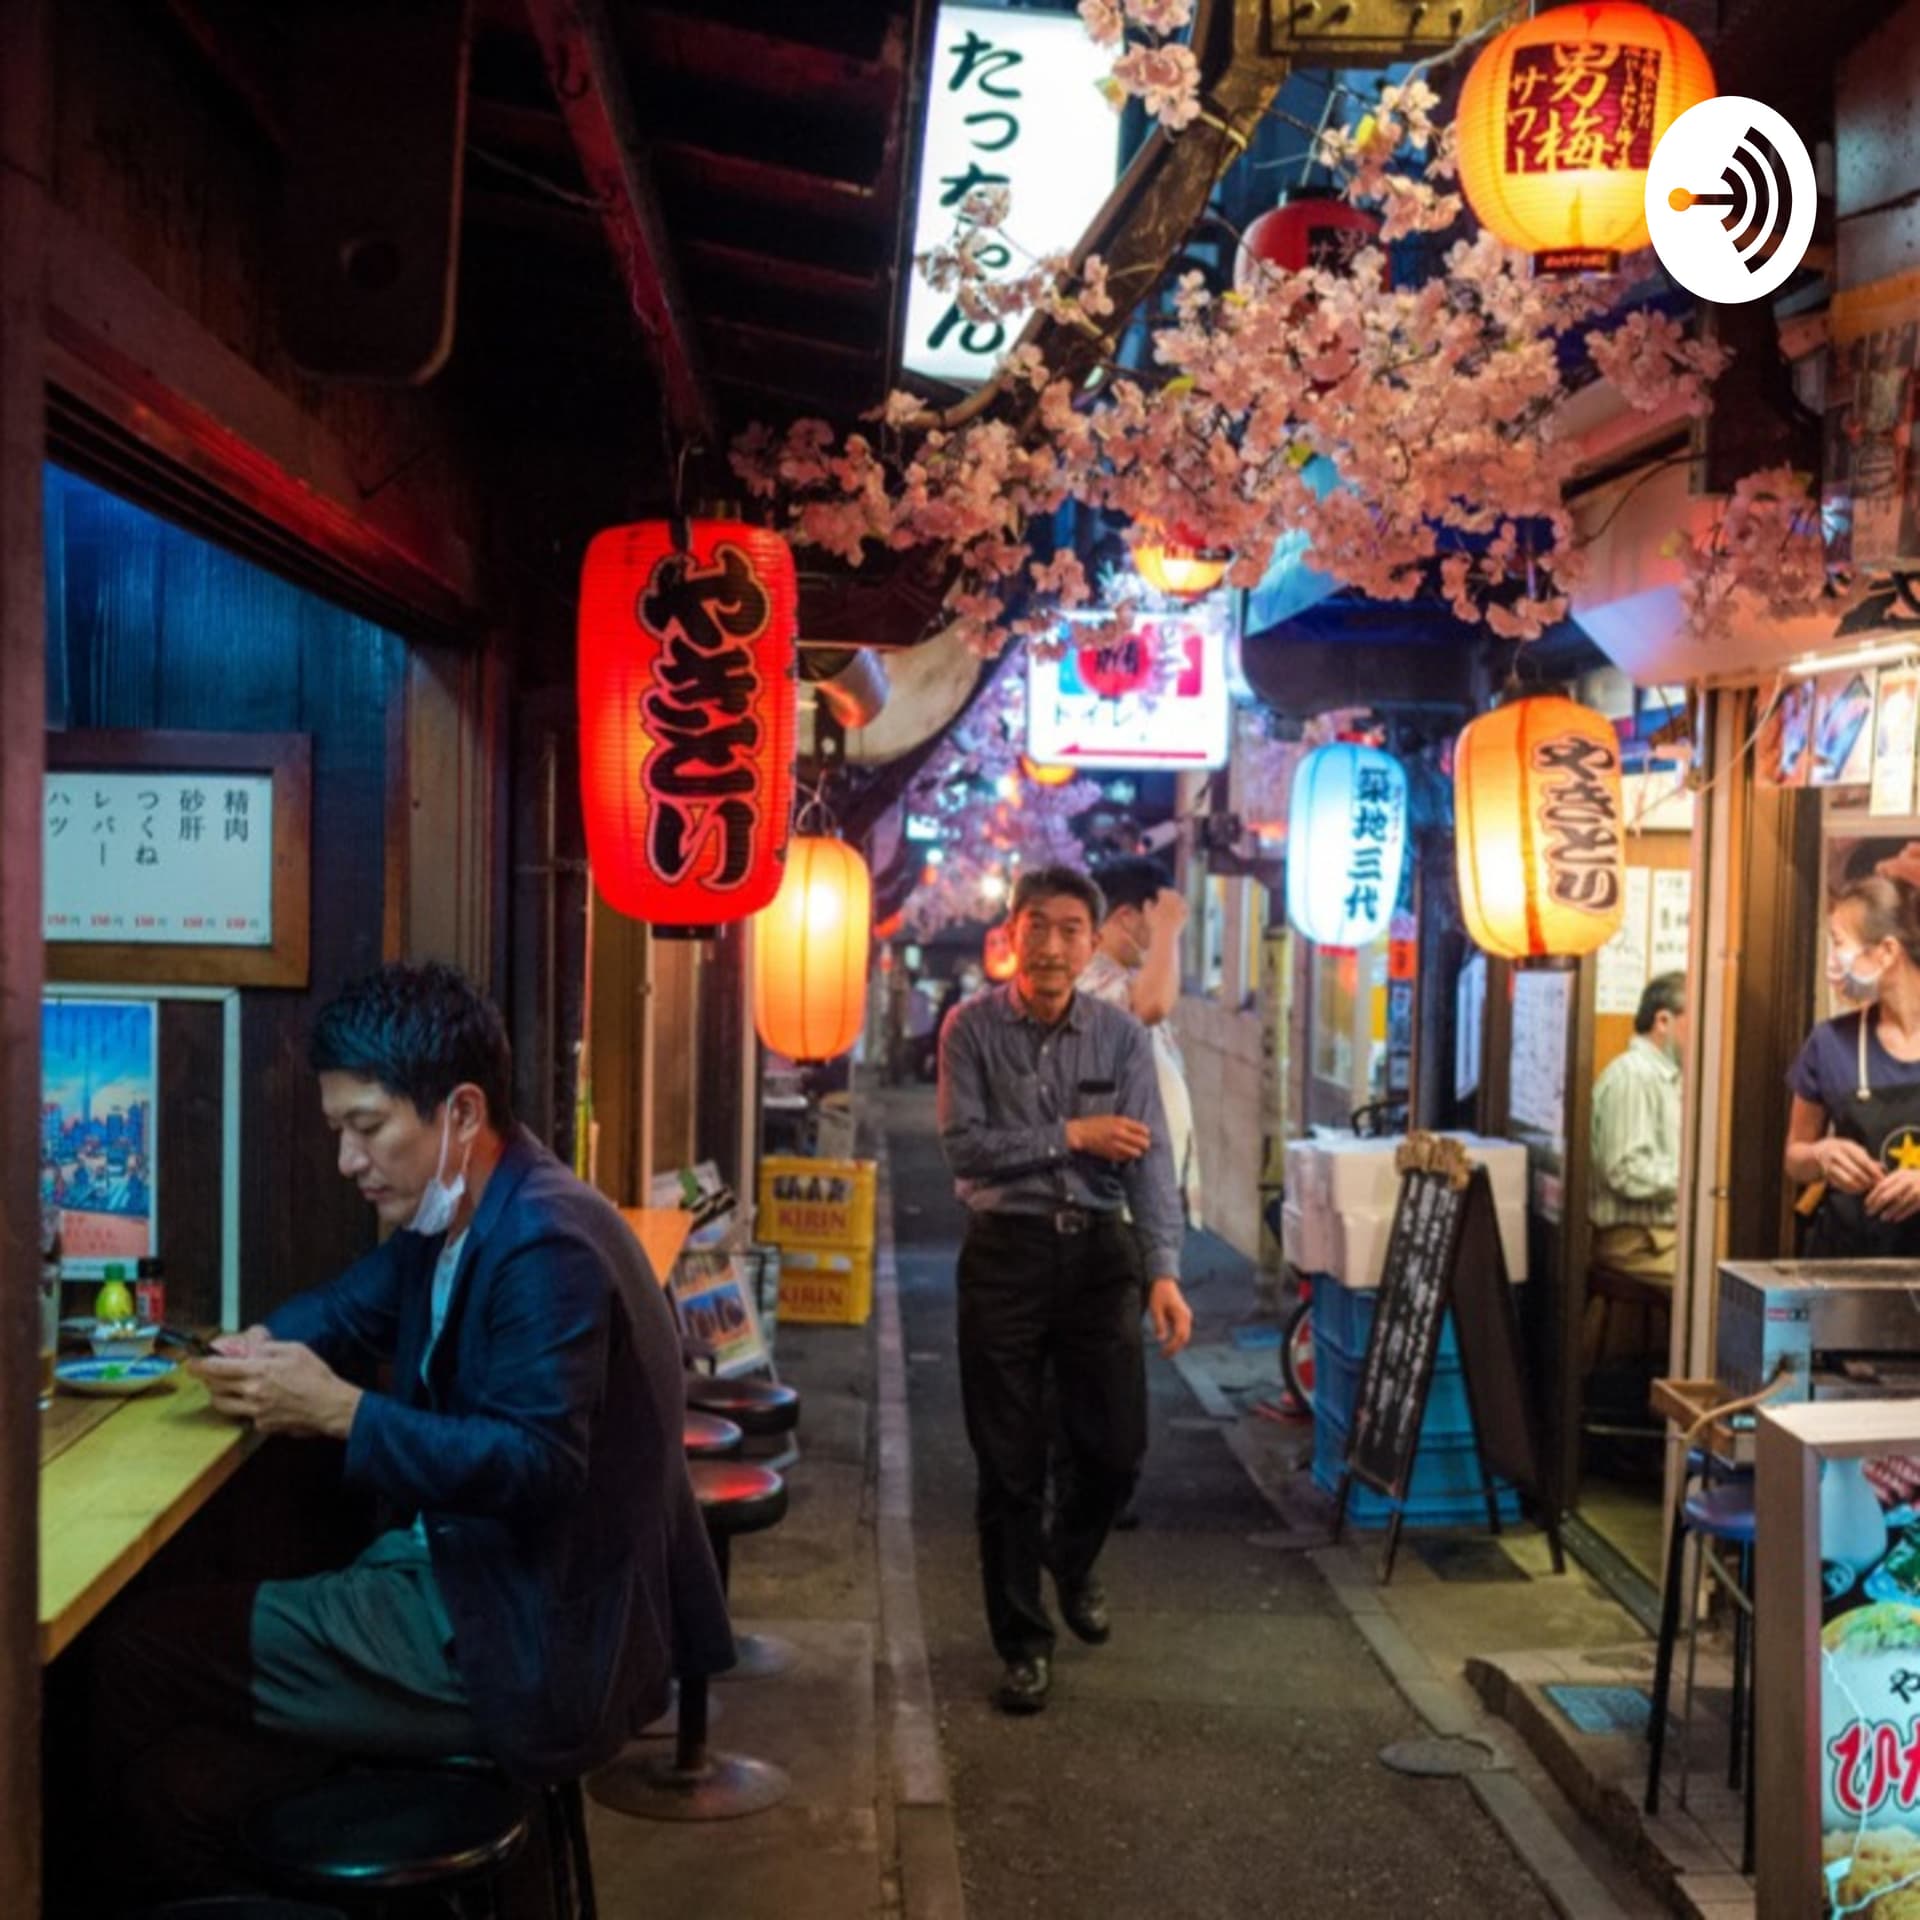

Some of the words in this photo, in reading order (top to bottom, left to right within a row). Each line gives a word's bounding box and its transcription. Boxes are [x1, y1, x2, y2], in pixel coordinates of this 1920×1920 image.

[1508, 64, 1548, 172] サワー
[1533, 42, 1621, 171] 男梅
[927, 29, 1024, 355] たっちん
[638, 544, 770, 890] やきとり
[48, 791, 72, 838] ハツ
[92, 790, 116, 867] レバー
[135, 790, 160, 866] つくね
[178, 788, 206, 842] 砂肝
[223, 788, 250, 842] 精肉
[1536, 734, 1620, 913] やきとり
[778, 1208, 847, 1229] KIRIN
